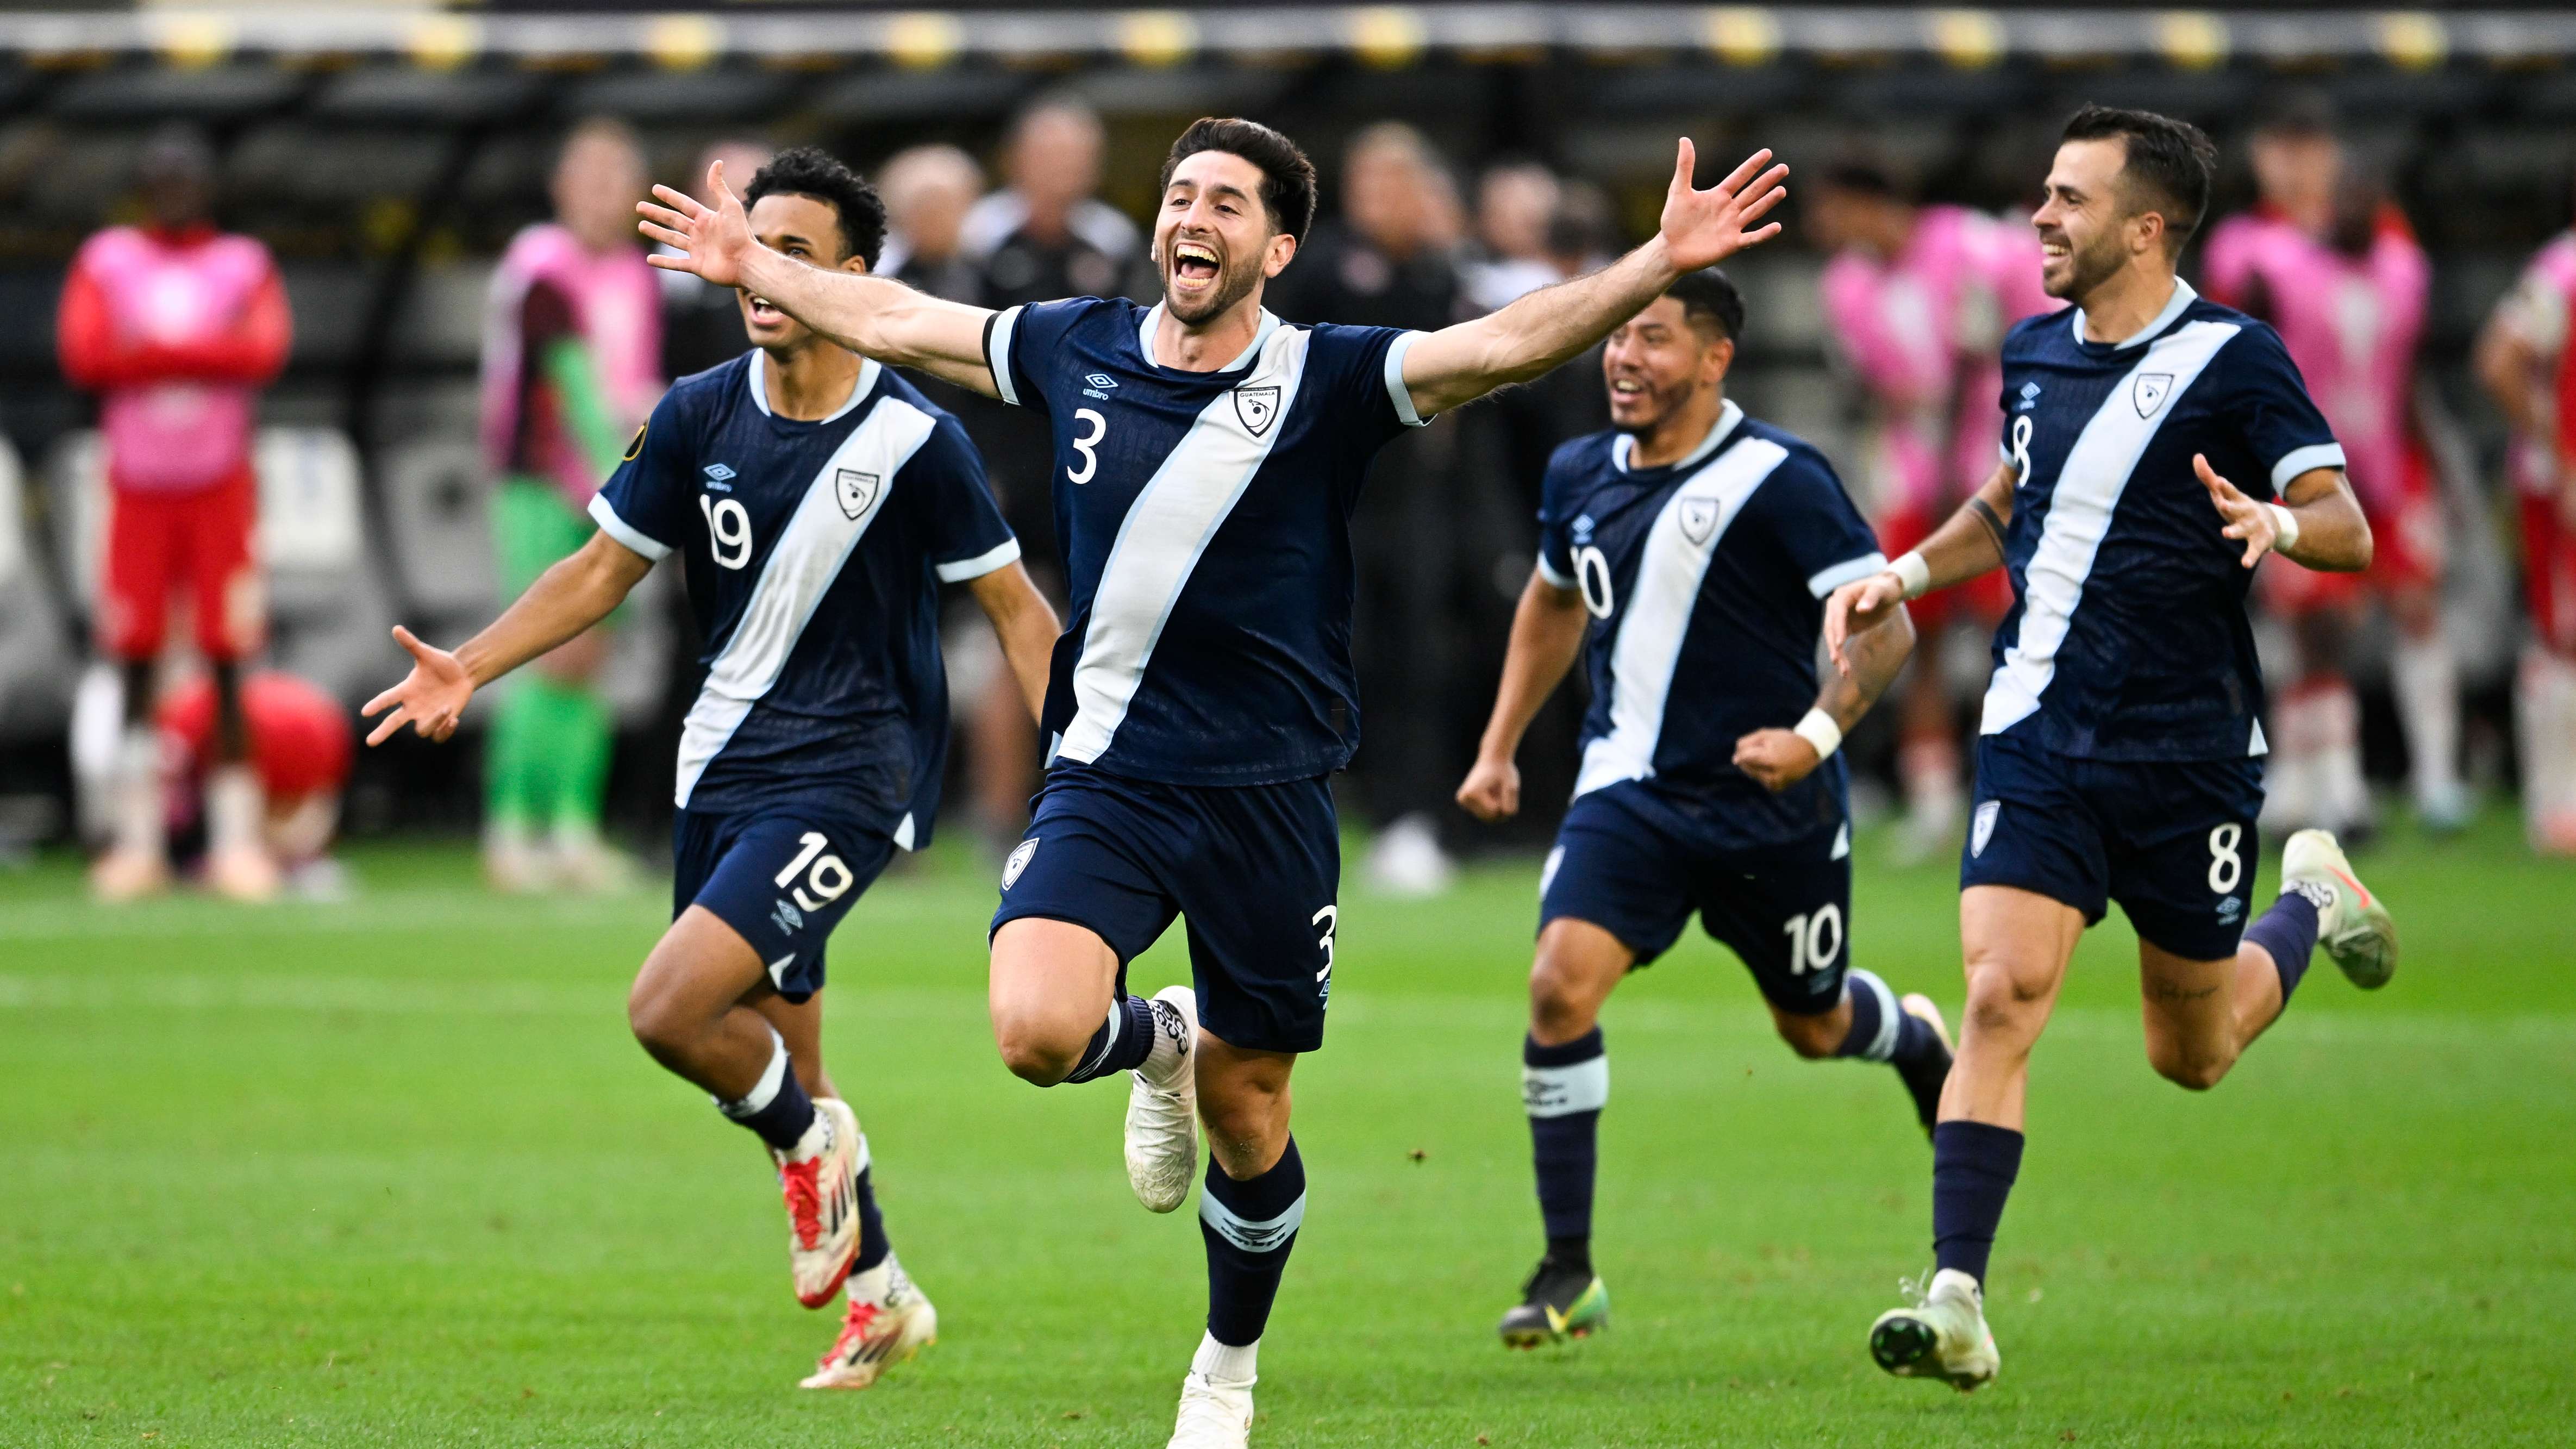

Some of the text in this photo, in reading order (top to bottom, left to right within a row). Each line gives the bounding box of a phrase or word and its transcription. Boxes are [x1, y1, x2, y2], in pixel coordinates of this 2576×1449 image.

[1083, 388, 1109, 401] umbro
[1067, 408, 1106, 485] 3
[2013, 415, 2033, 488] 8
[699, 494, 752, 570] 19
[774, 832, 853, 913] 19
[2209, 822, 2242, 894] 8
[1312, 904, 1337, 982] 3
[1783, 902, 1842, 976] 10
[1221, 1226, 1286, 1247] umbro
